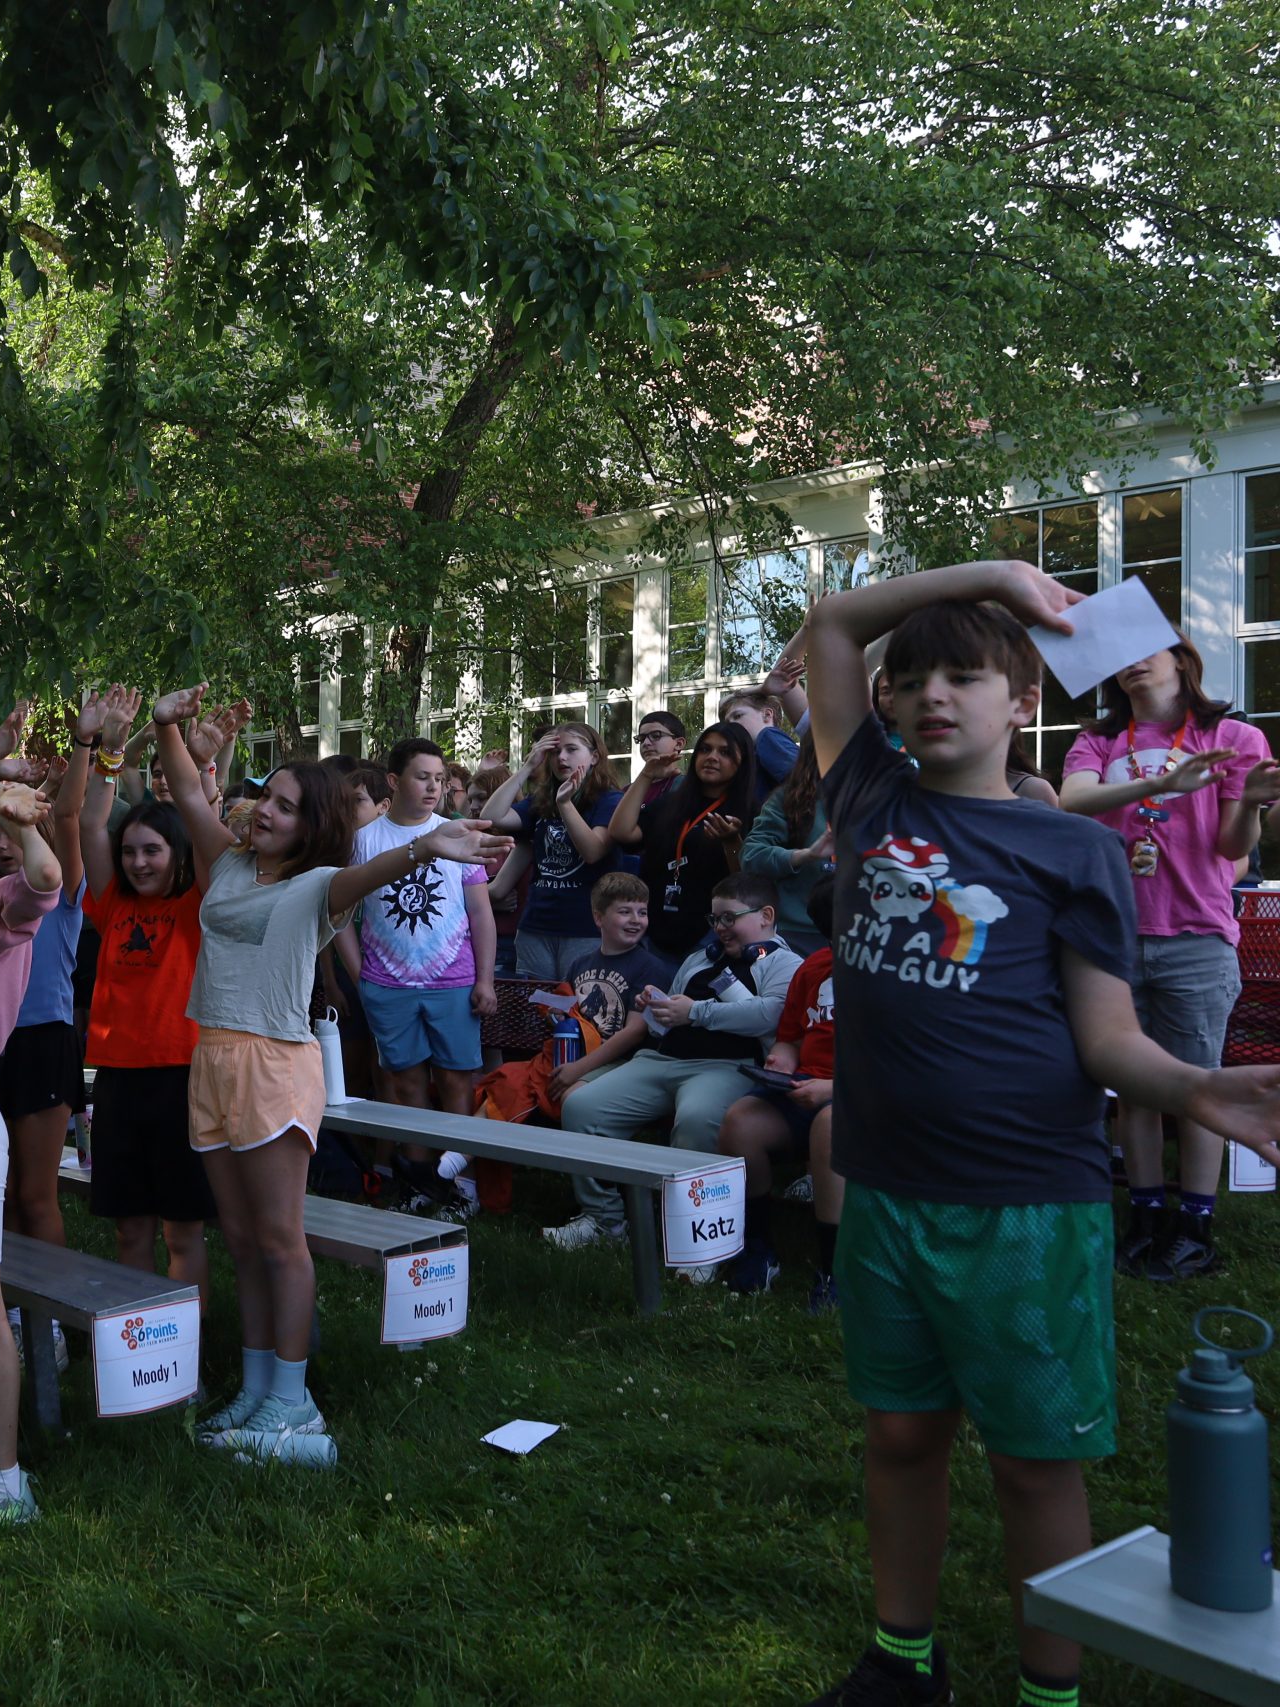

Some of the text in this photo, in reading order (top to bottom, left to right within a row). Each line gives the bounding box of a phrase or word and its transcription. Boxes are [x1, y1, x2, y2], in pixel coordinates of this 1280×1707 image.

[847, 913, 893, 947] I'M
[903, 931, 932, 956] A
[574, 968, 598, 988] HIDE
[605, 970, 630, 994] SEEK
[691, 1216, 736, 1243] Katz
[414, 1297, 453, 1320] Moody 1
[138, 1322, 178, 1342] 6Points
[132, 1360, 178, 1388] Moody 1
